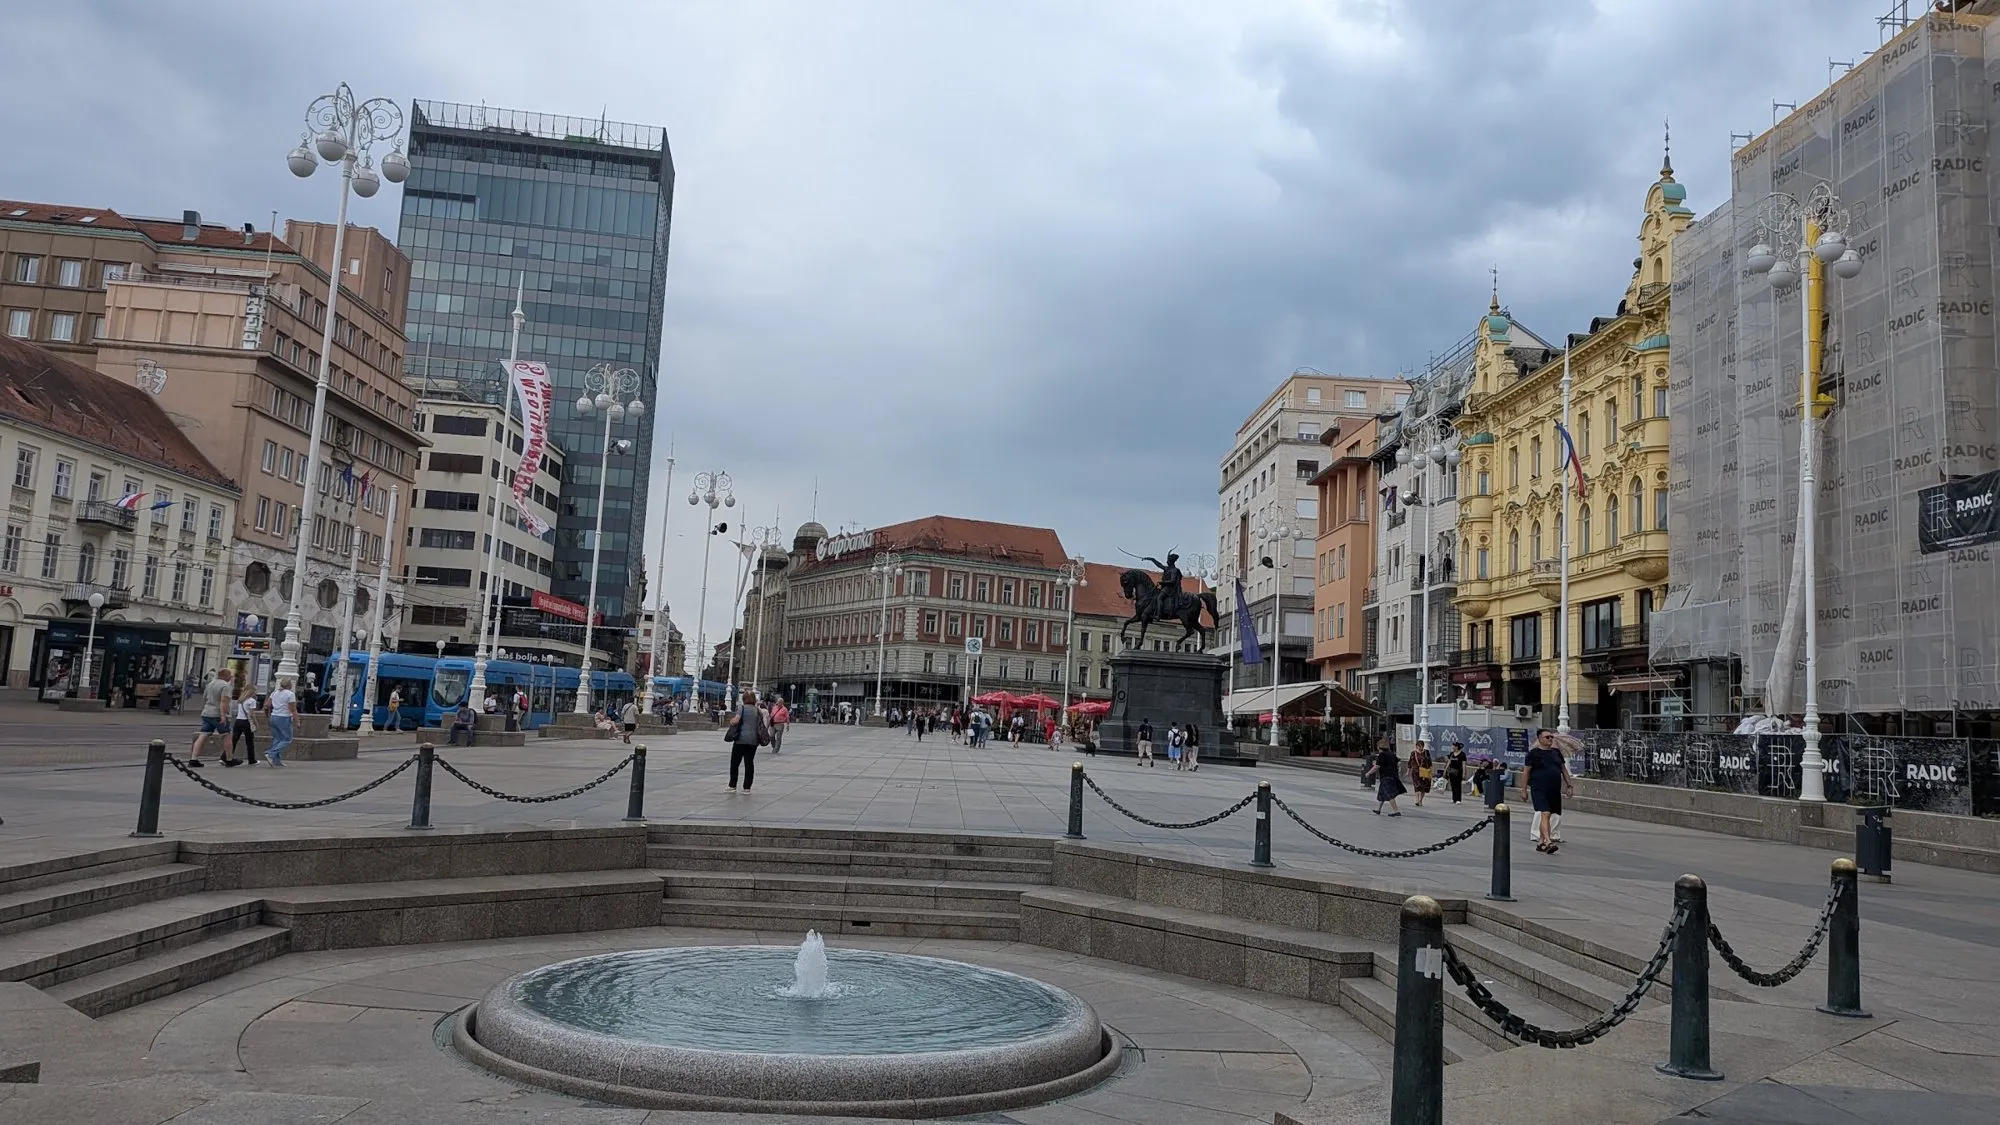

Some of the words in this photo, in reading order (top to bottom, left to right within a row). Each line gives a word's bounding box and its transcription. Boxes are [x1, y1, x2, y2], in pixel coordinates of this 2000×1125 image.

[1844, 106, 1876, 134] RADIĆ
[1931, 157, 1983, 173] RADIĆ
[1883, 169, 1920, 198] RADIĆ
[1937, 300, 1990, 316] RADIĆ
[1889, 305, 1925, 332] RADIĆ
[1849, 370, 1882, 393] RADIĆ
[1895, 448, 1932, 471] RADIĆ
[1942, 443, 1997, 460] RADIĆ
[1956, 489, 1993, 513] RADIĆ
[1855, 506, 1889, 527] RADIĆ
[1948, 546, 1990, 563] RADIĆ
[1818, 605, 1850, 620] RADIĆ
[1901, 594, 1940, 614] RADIĆ
[1752, 620, 1779, 635] RADIĆ
[515, 652, 540, 663] bolje,
[1860, 645, 1894, 663] RADIĆ
[1652, 749, 1681, 765] RADIĆ
[1719, 752, 1751, 770] RADIĆ
[1906, 761, 1958, 782] RADIĆ
